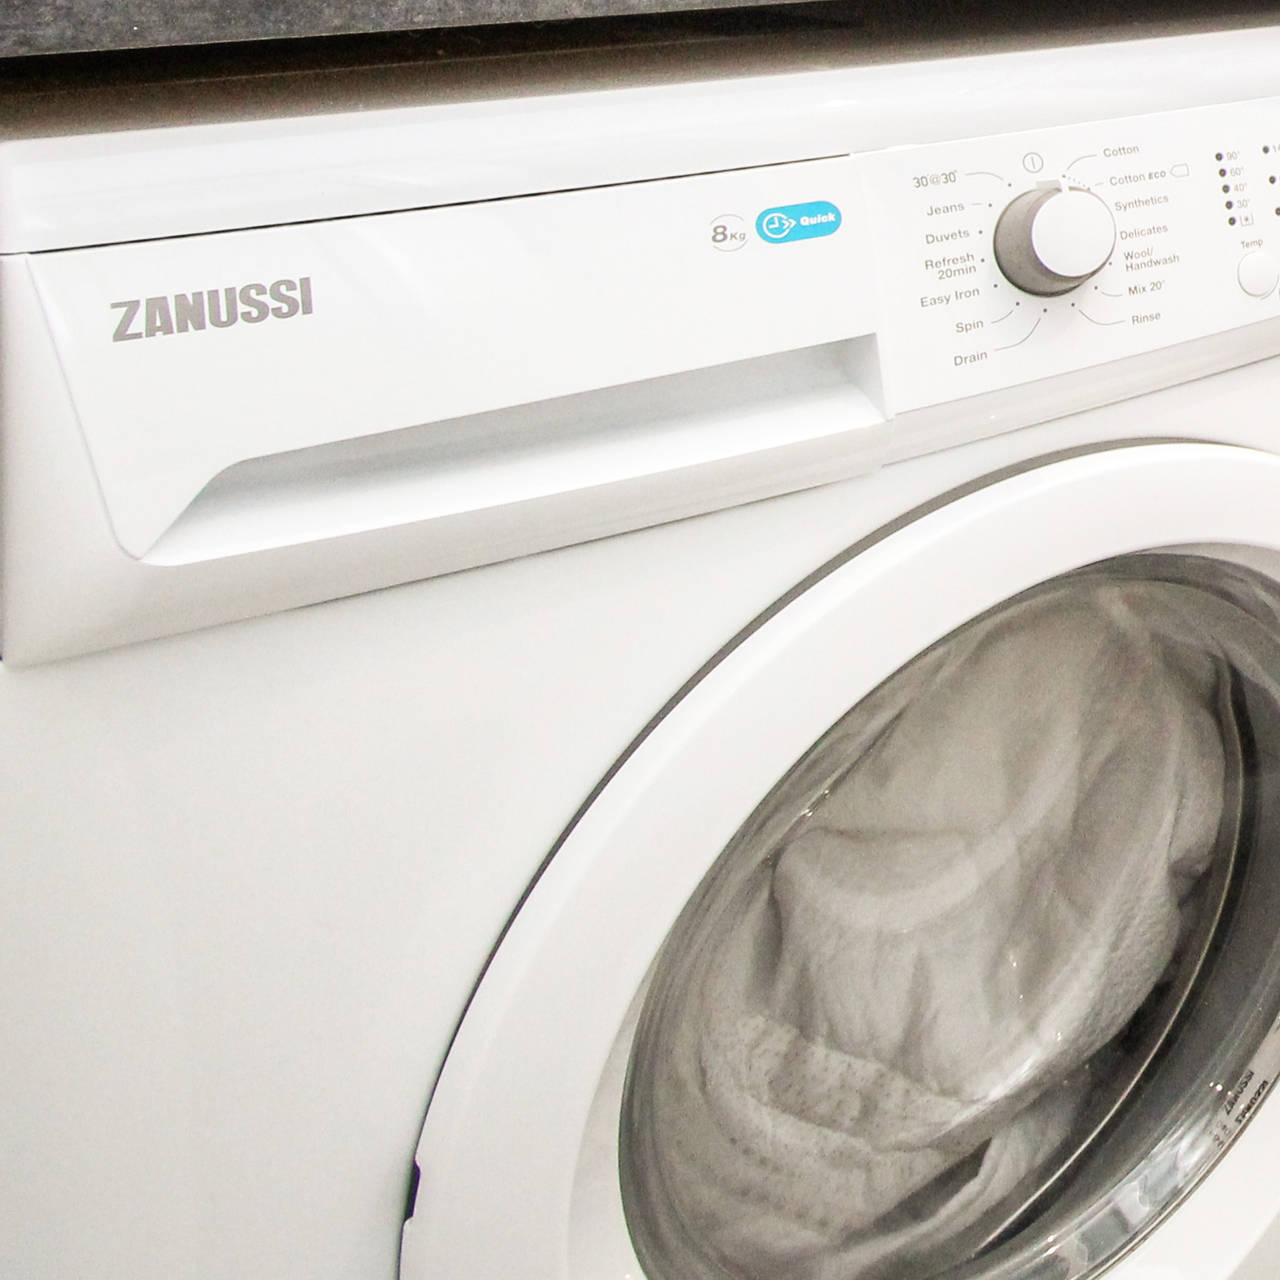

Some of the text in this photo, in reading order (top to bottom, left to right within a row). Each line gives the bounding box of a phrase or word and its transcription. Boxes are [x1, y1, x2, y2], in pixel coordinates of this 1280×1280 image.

[1103, 144, 1140, 158] Cotton
[1109, 173, 1146, 187] Cotton
[926, 201, 965, 217] Jeans
[1114, 193, 1169, 213] Synthetics
[800, 211, 836, 227] Quick
[925, 228, 970, 245] Duvets
[1119, 223, 1169, 241] Delicates
[1241, 239, 1263, 250] Temp
[924, 252, 975, 271] Refresh
[1123, 246, 1154, 262] Wool/
[1124, 253, 1180, 273] Handwash
[937, 264, 977, 281] 20min
[920, 287, 981, 308] Easy Iron
[1128, 284, 1147, 297] Mix
[109, 276, 314, 343] ZANUSSI
[955, 318, 985, 334] Spin
[1131, 311, 1161, 326] Rinse
[953, 350, 988, 367] Drain
